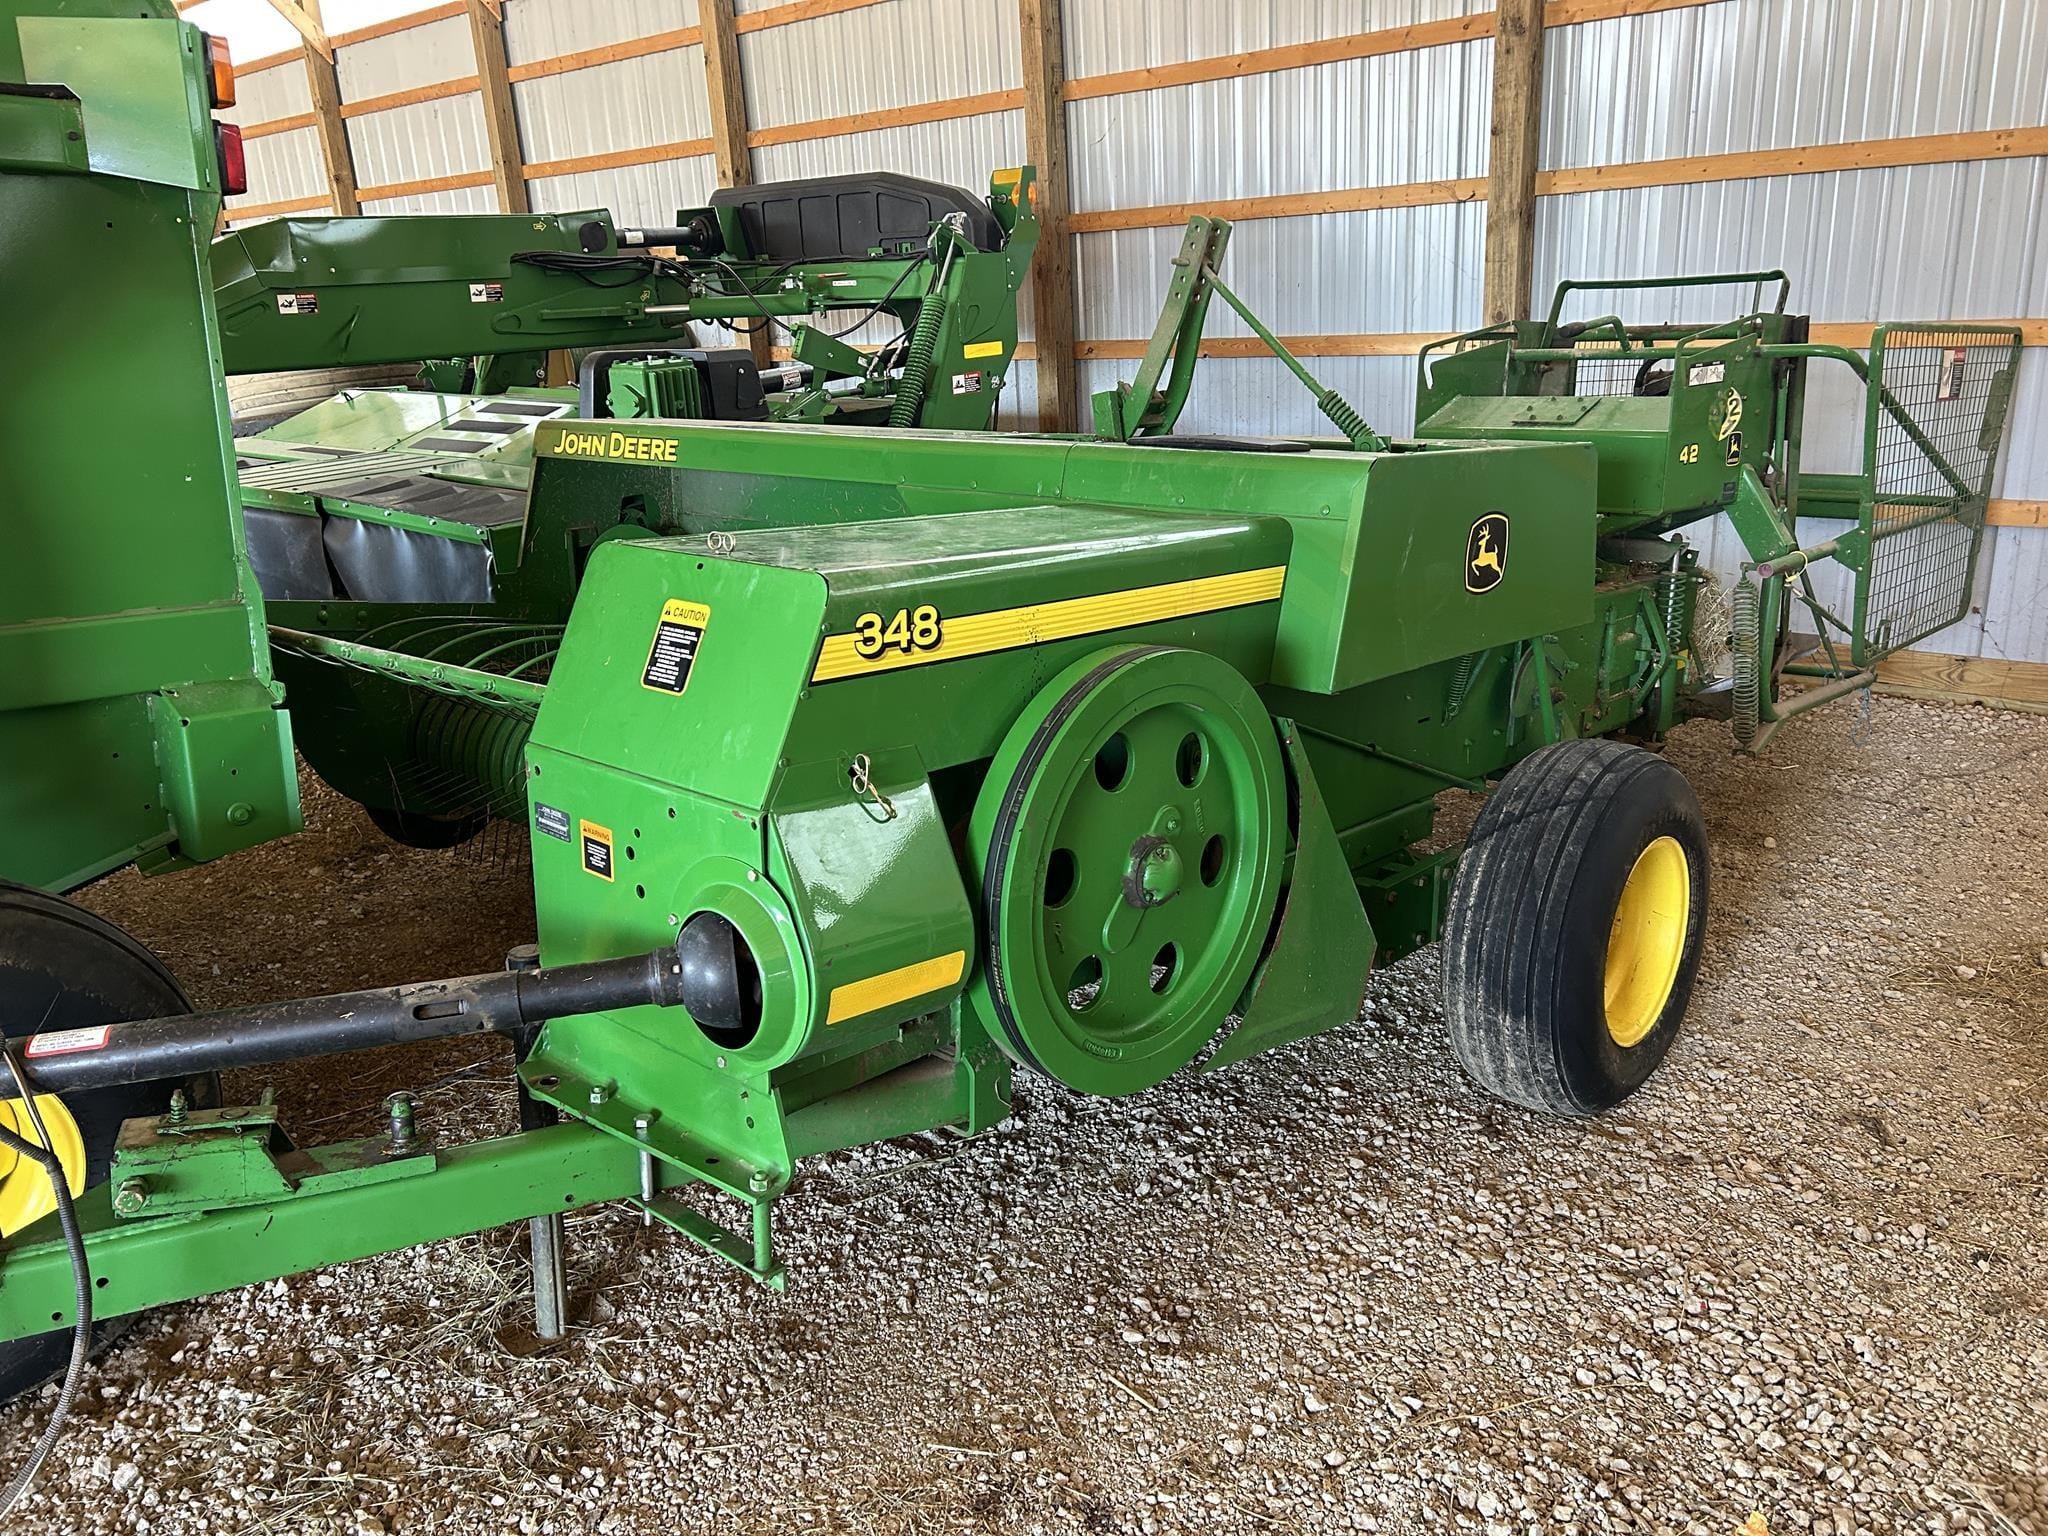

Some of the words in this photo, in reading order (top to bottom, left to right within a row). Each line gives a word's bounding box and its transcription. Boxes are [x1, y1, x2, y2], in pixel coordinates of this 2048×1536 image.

[553, 429, 606, 457] JOHN
[608, 431, 679, 462] DEERE
[1679, 443, 1699, 464] 42
[673, 607, 707, 622] CAUTION
[854, 604, 943, 660] 348
